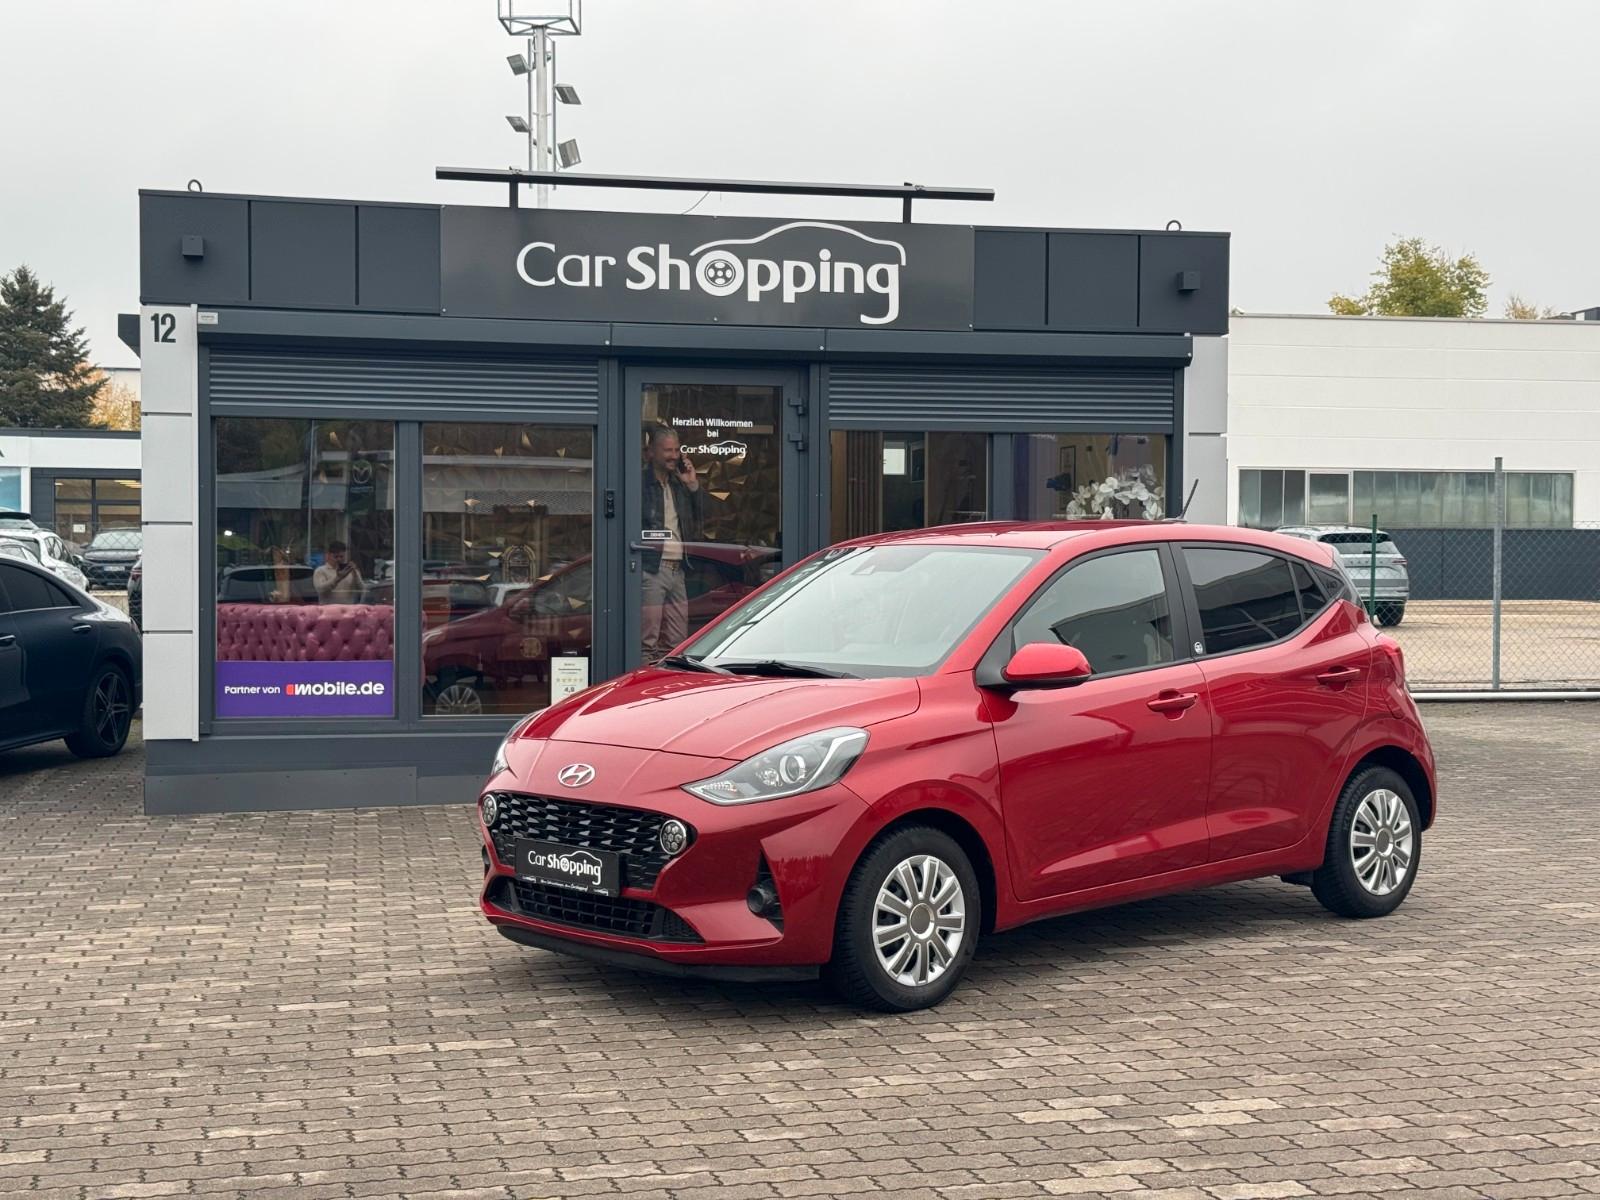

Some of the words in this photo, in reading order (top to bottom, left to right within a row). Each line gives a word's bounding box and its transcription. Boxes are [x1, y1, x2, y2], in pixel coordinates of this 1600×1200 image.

[515, 241, 617, 287] Car
[625, 243, 901, 325] Shopping
[150, 313, 176, 343] 12
[672, 417, 704, 427] Herzlich
[705, 418, 753, 428] Willkommen
[706, 429, 719, 438] bei
[680, 445, 698, 454] Car
[698, 444, 746, 459] Shopping
[224, 685, 260, 695] Partner
[262, 686, 281, 695] von
[294, 681, 385, 696] mobile.de
[528, 850, 547, 867] Car
[547, 853, 602, 885] Shopping
